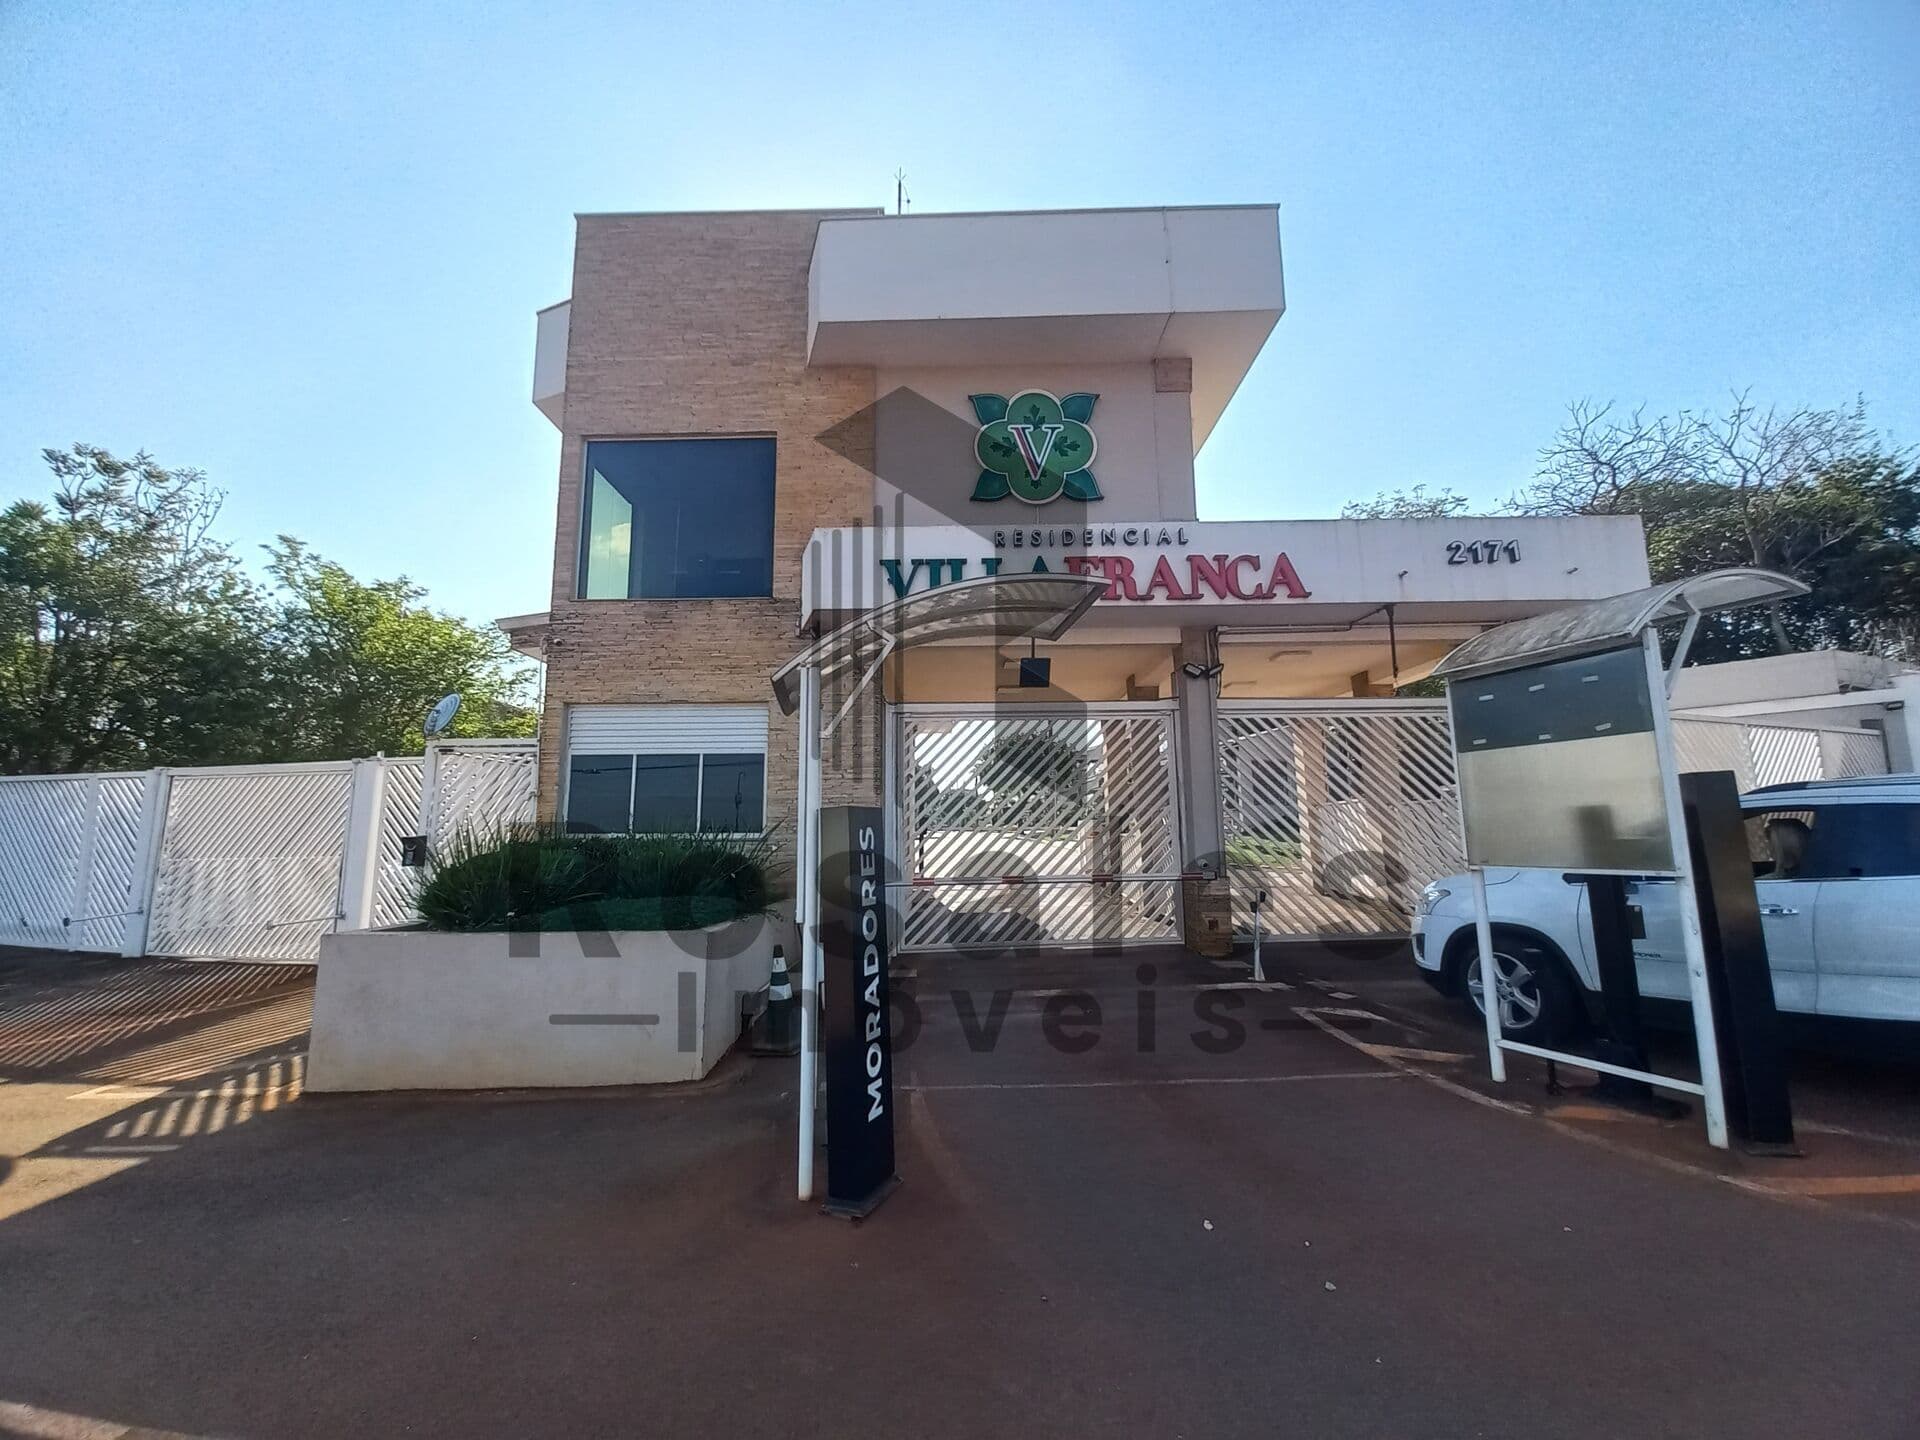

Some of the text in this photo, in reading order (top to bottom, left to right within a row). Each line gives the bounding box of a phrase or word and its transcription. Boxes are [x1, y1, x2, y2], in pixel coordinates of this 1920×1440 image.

[1007, 424, 1064, 481] V
[993, 527, 1190, 548] RESIDENCIAL
[1446, 539, 1521, 565] 2171
[859, 825, 884, 1123] MORADORES
